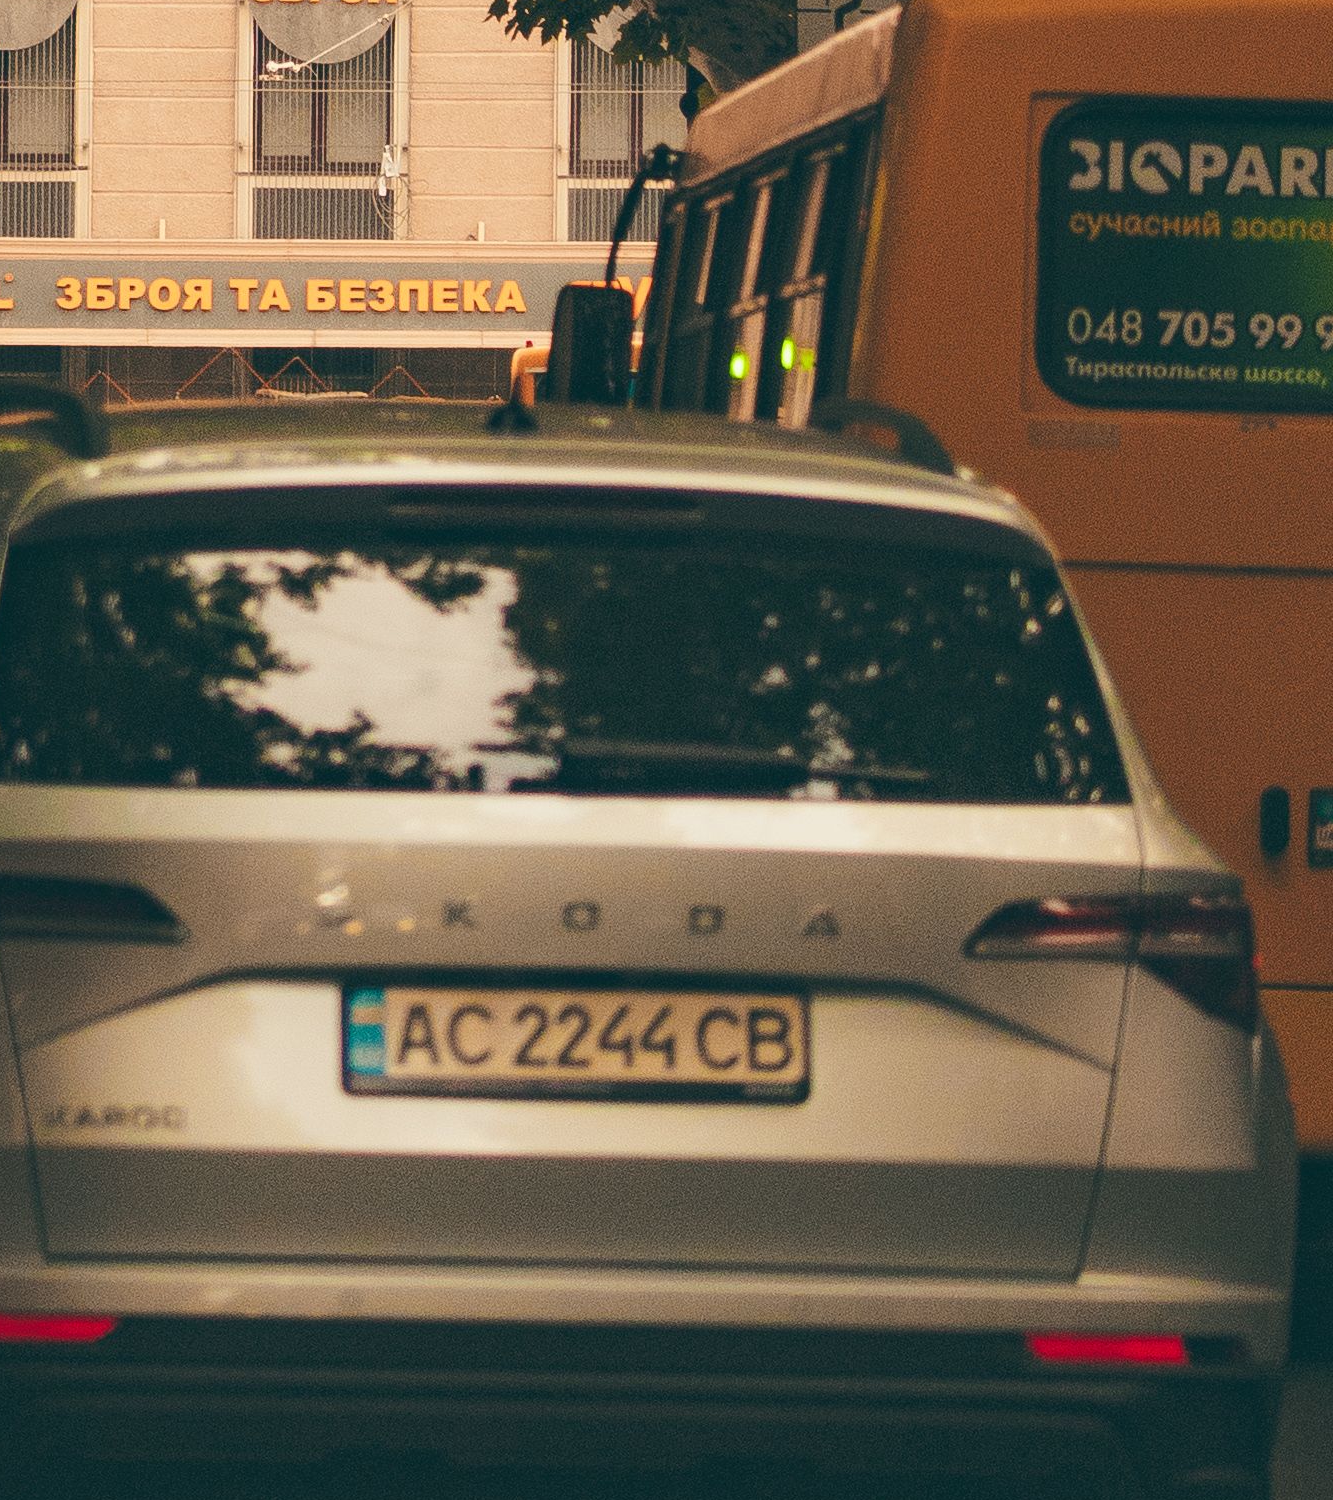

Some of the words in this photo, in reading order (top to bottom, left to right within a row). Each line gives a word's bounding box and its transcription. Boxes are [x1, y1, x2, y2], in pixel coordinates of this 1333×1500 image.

[1068, 210, 1221, 242] сучасний
[1232, 216, 1333, 242] зоопа
[56, 277, 213, 312] ЗБРОЯ
[230, 278, 291, 312] ТА
[306, 278, 528, 314] БЕЗПЕКА
[1067, 307, 1144, 346] 048
[1157, 311, 1236, 349] 705
[1249, 313, 1303, 351] 99
[396, 1003, 493, 1066] AC
[513, 1004, 677, 1070] 2244
[695, 1007, 795, 1074] CB
